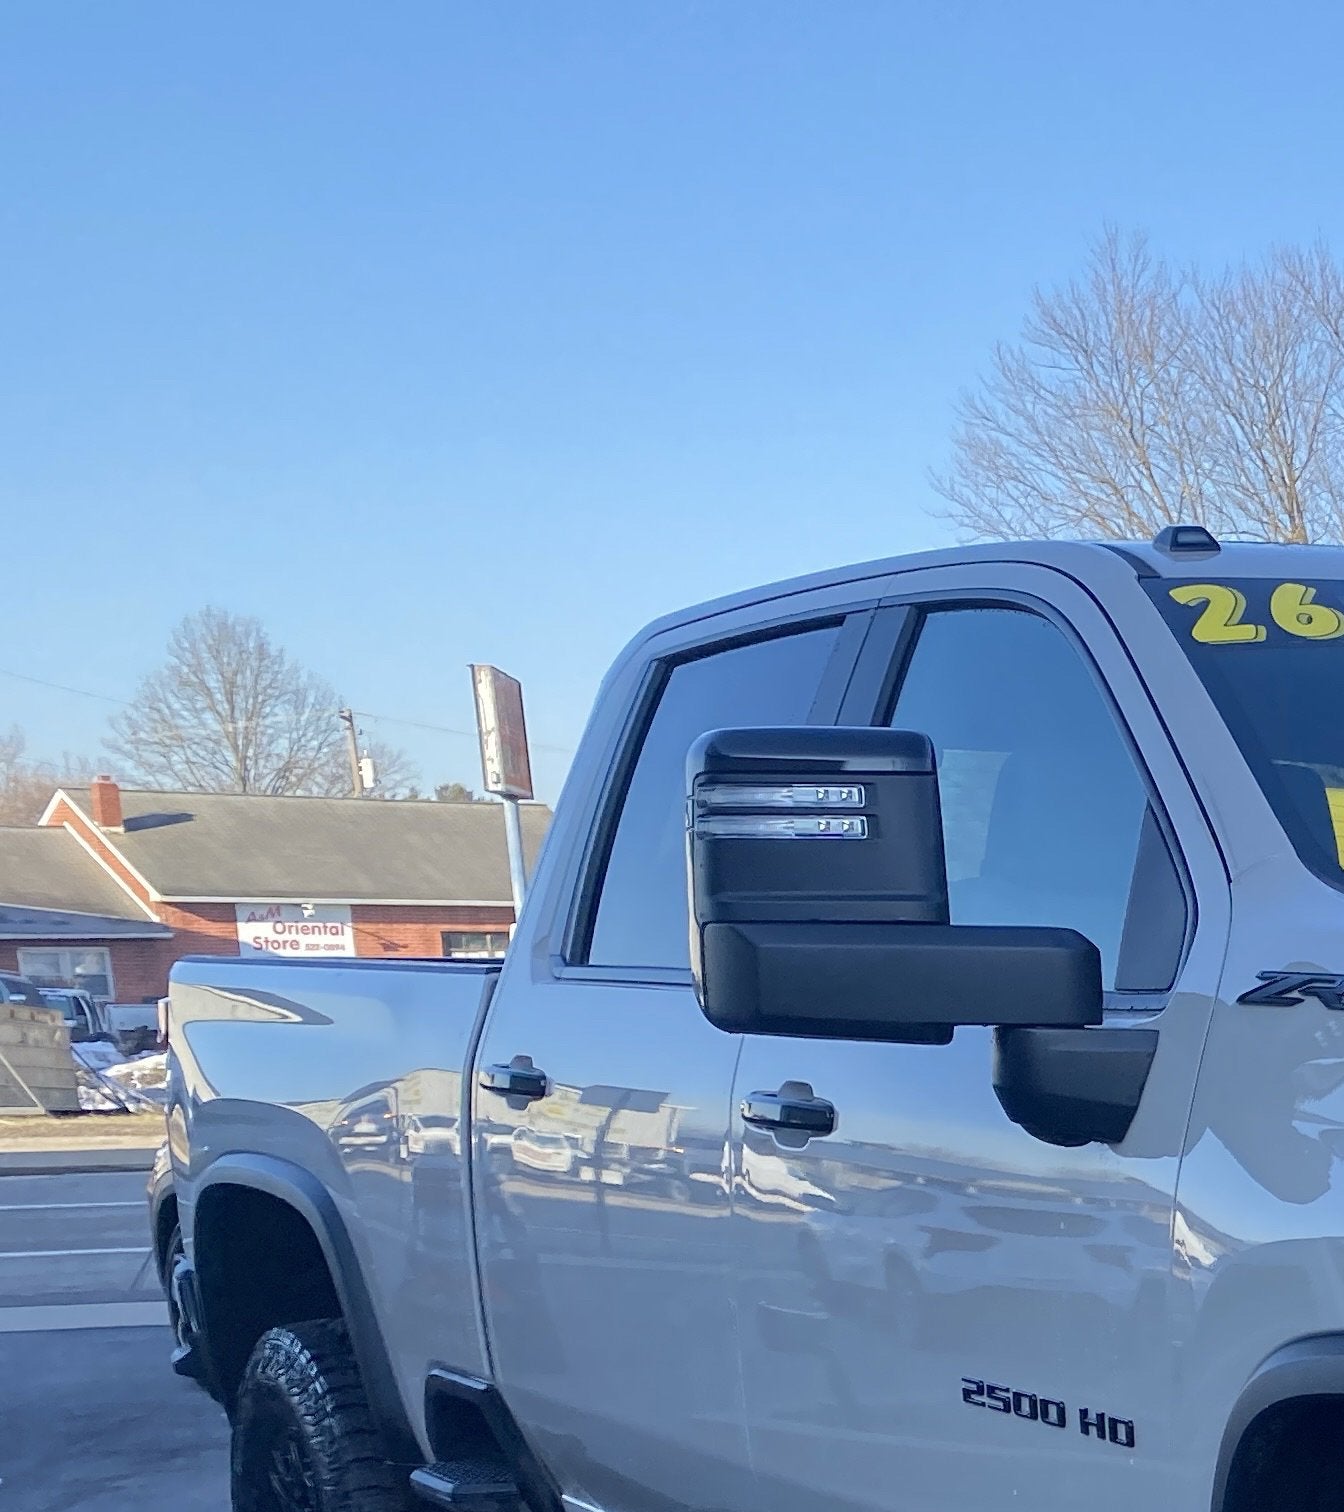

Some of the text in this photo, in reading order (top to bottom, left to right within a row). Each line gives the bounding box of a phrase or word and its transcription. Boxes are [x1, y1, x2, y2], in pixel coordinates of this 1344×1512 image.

[247, 905, 281, 923] A&M
[272, 920, 345, 936] Oriental
[253, 936, 301, 950] Store
[962, 1375, 1136, 1449] 2500 HD
